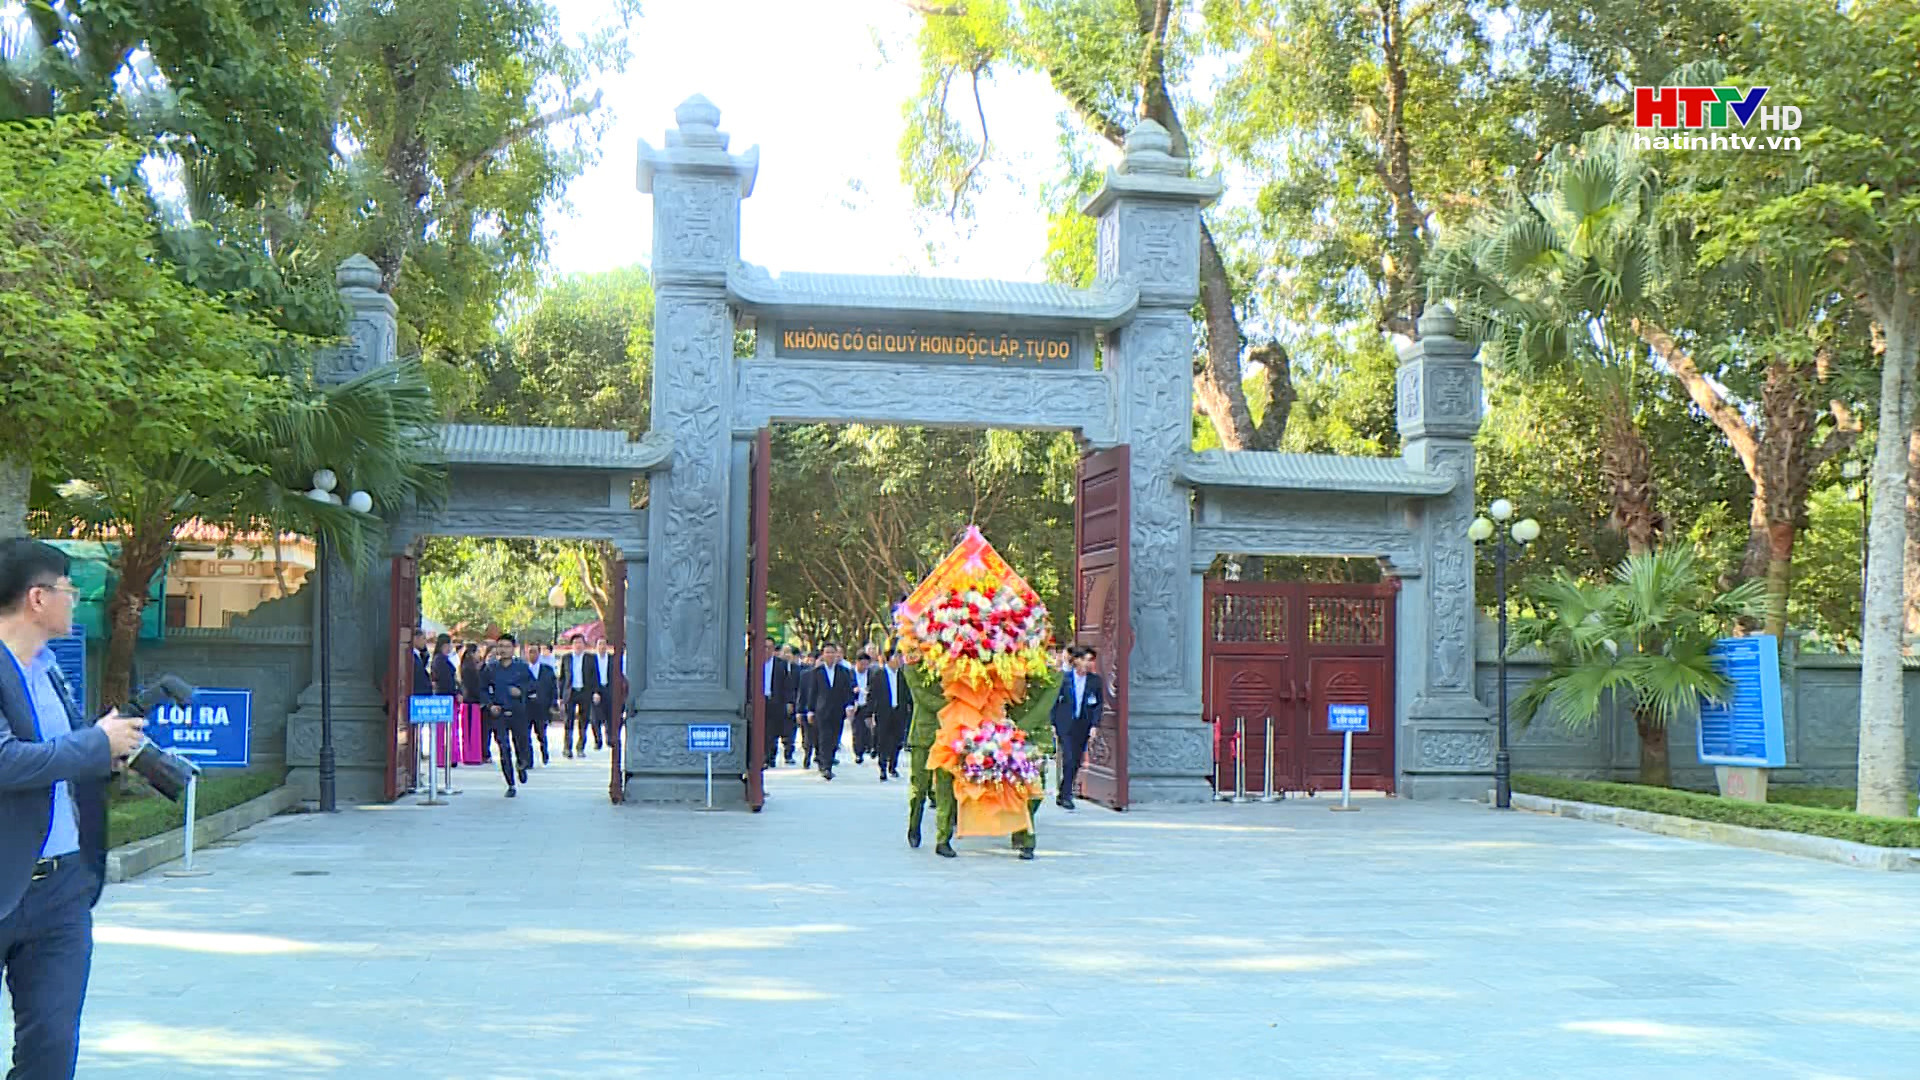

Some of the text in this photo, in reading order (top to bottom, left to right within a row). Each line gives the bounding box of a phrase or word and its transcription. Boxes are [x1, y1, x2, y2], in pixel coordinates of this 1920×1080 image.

[783, 326, 840, 351] KHÔNG
[842, 327, 864, 351] CÓ
[866, 329, 882, 352] GÌ
[884, 329, 917, 353] QUÝ
[1047, 341, 1070, 359] DO
[199, 706, 230, 726] RA
[173, 729, 212, 742] EXIT
